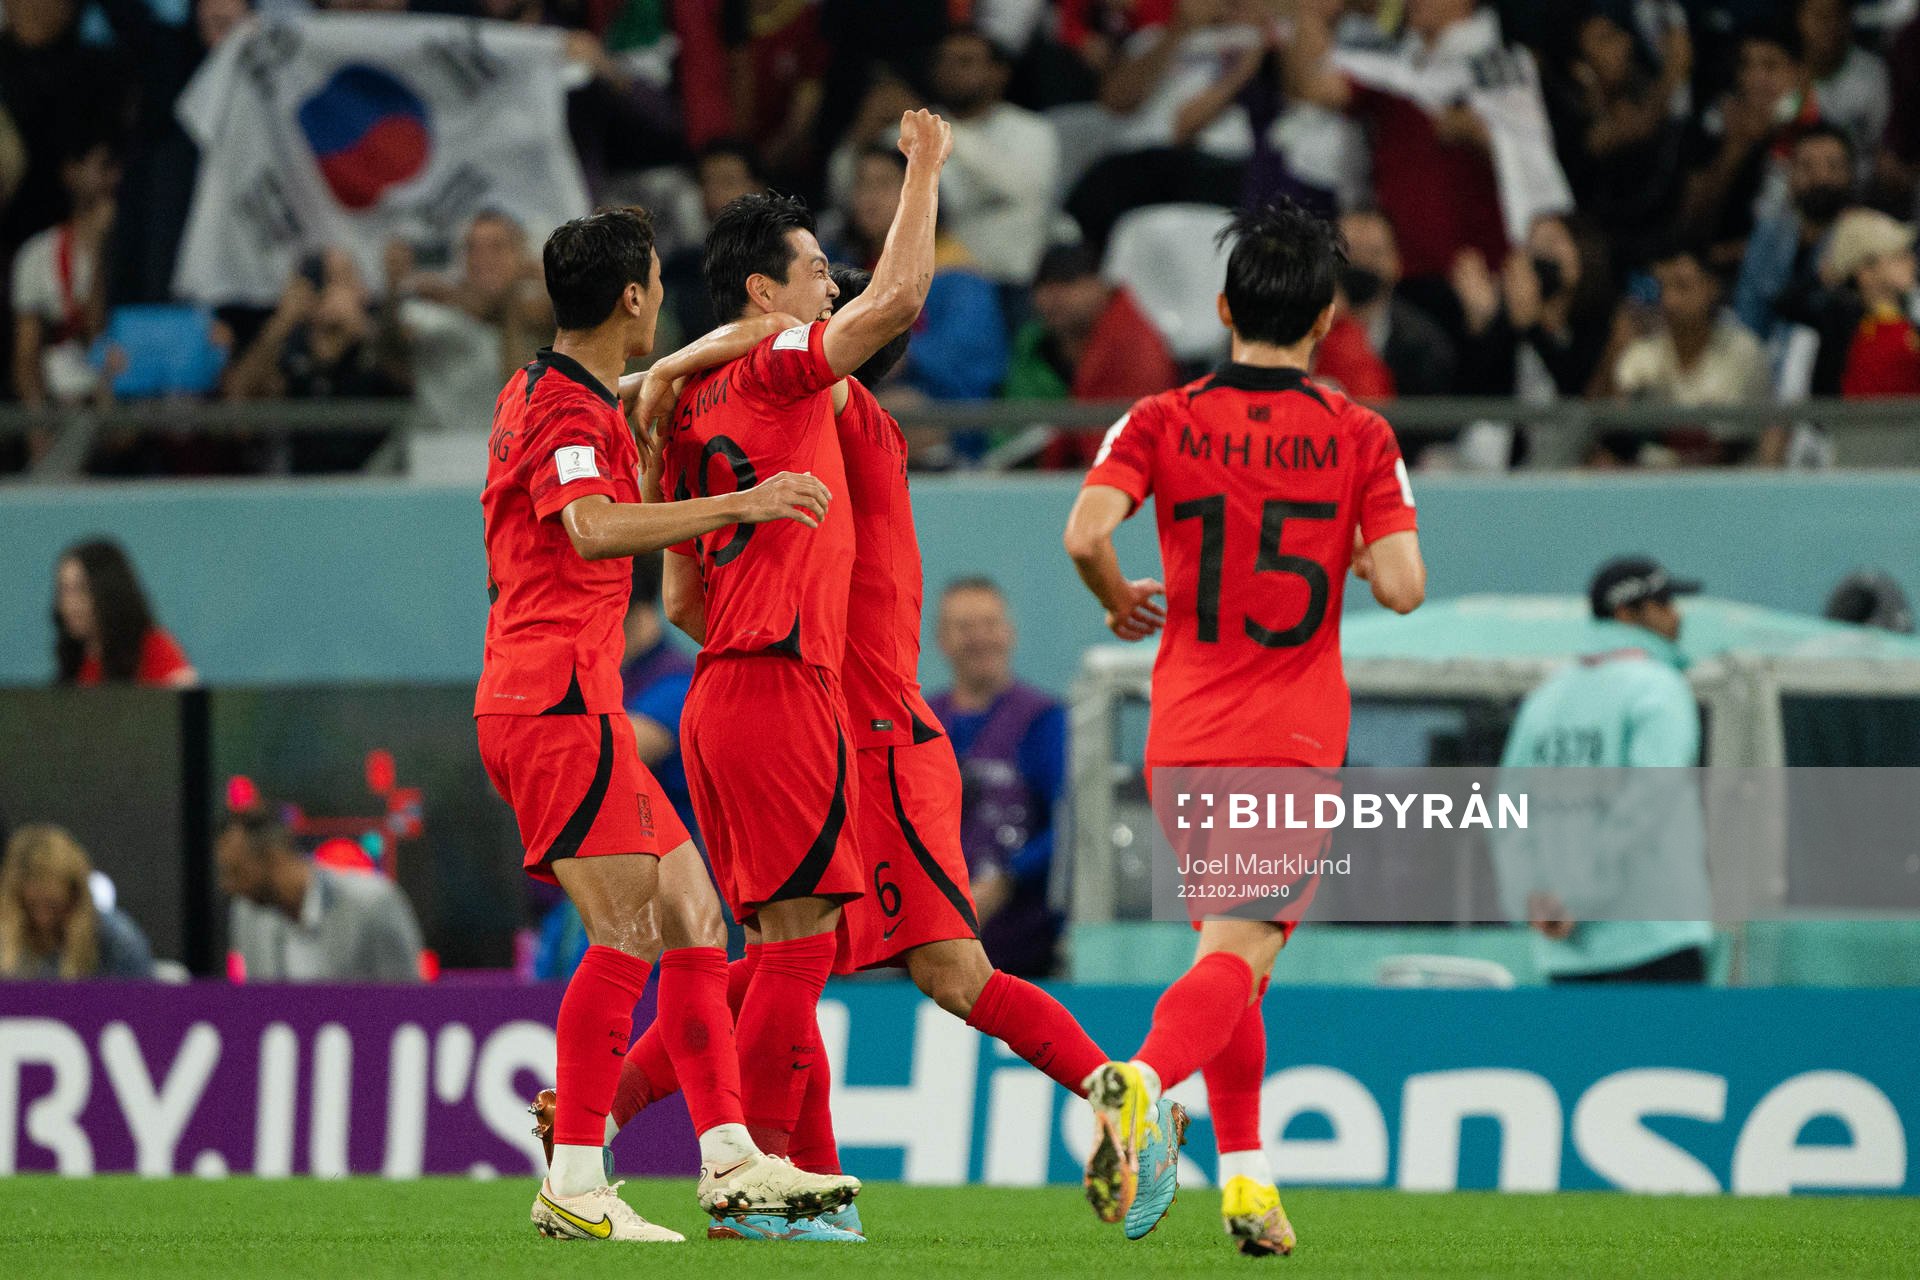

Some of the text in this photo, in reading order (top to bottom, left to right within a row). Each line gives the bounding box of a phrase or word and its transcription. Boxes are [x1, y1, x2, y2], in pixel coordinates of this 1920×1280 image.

[1180, 427, 1337, 469] M H KIM
[1173, 495, 1337, 649] 15
[874, 862, 902, 918] 6
